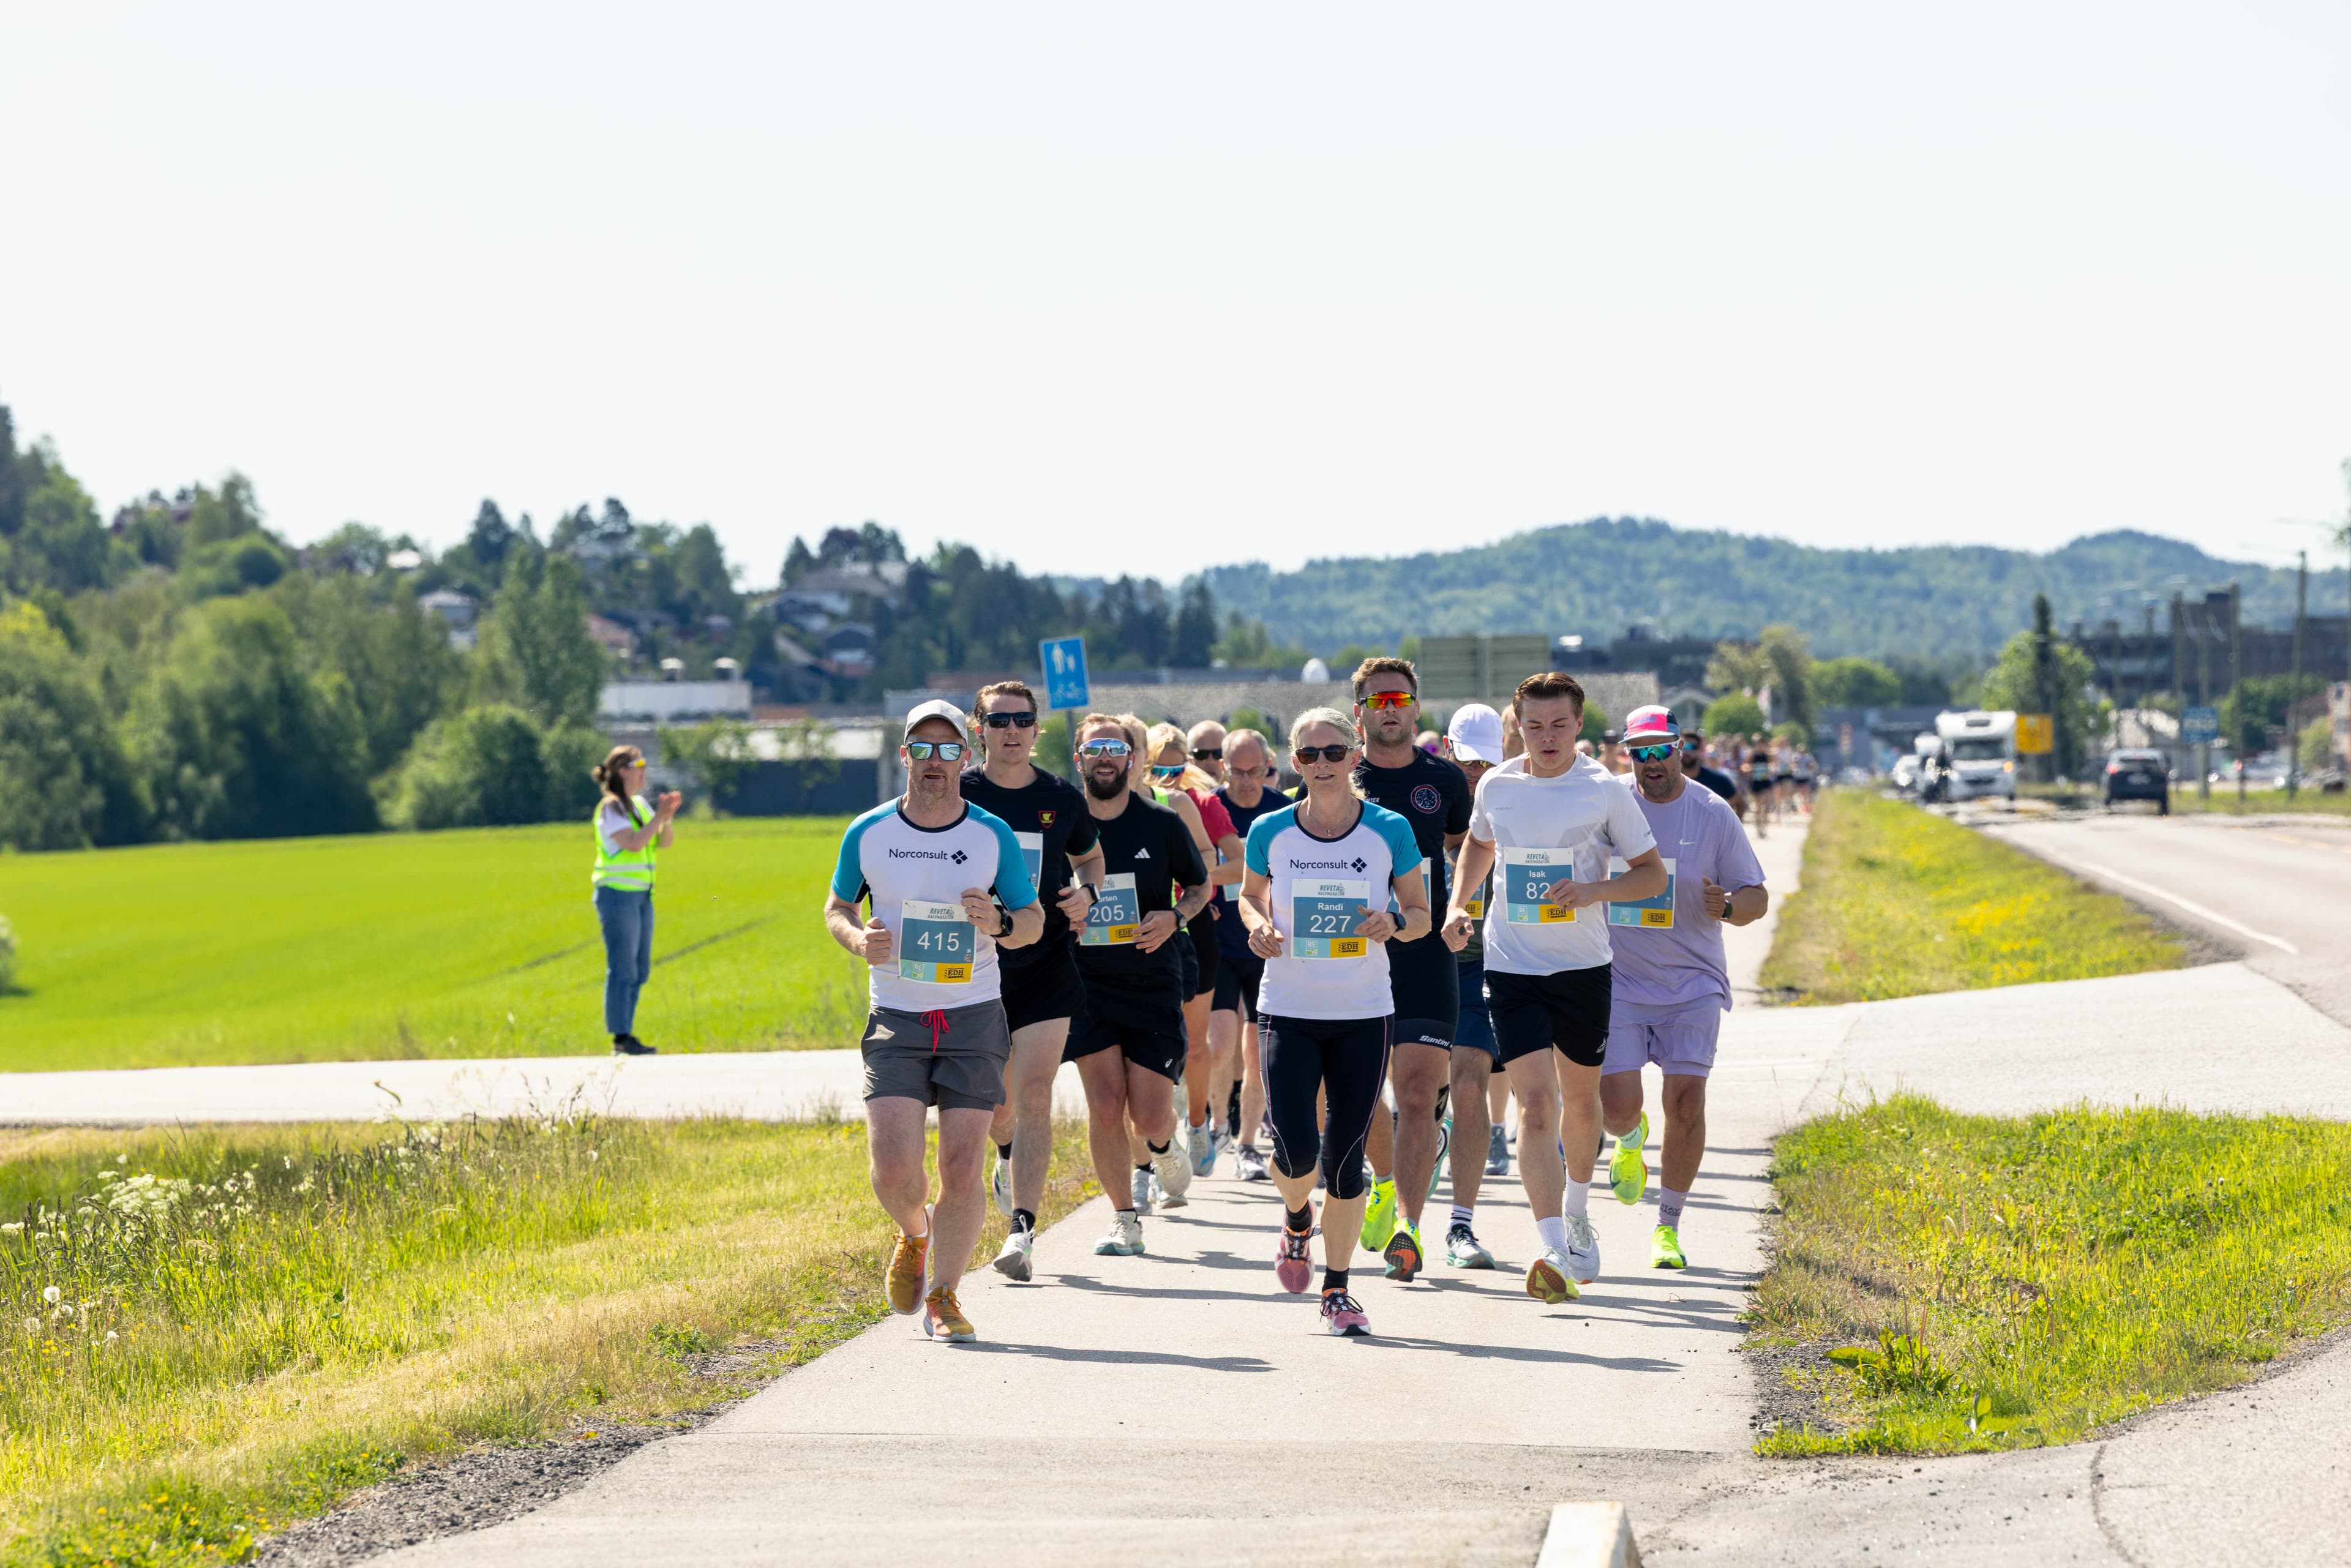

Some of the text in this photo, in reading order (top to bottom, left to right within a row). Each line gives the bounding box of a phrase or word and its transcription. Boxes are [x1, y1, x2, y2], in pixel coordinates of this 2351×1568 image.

[889, 849, 948, 860] Norconsult
[1290, 860, 1348, 869] Norconsult
[1089, 905, 1124, 923] 205
[1310, 915, 1352, 933] 227
[917, 931, 959, 951] 415
[1419, 1035, 1450, 1046] Santini
